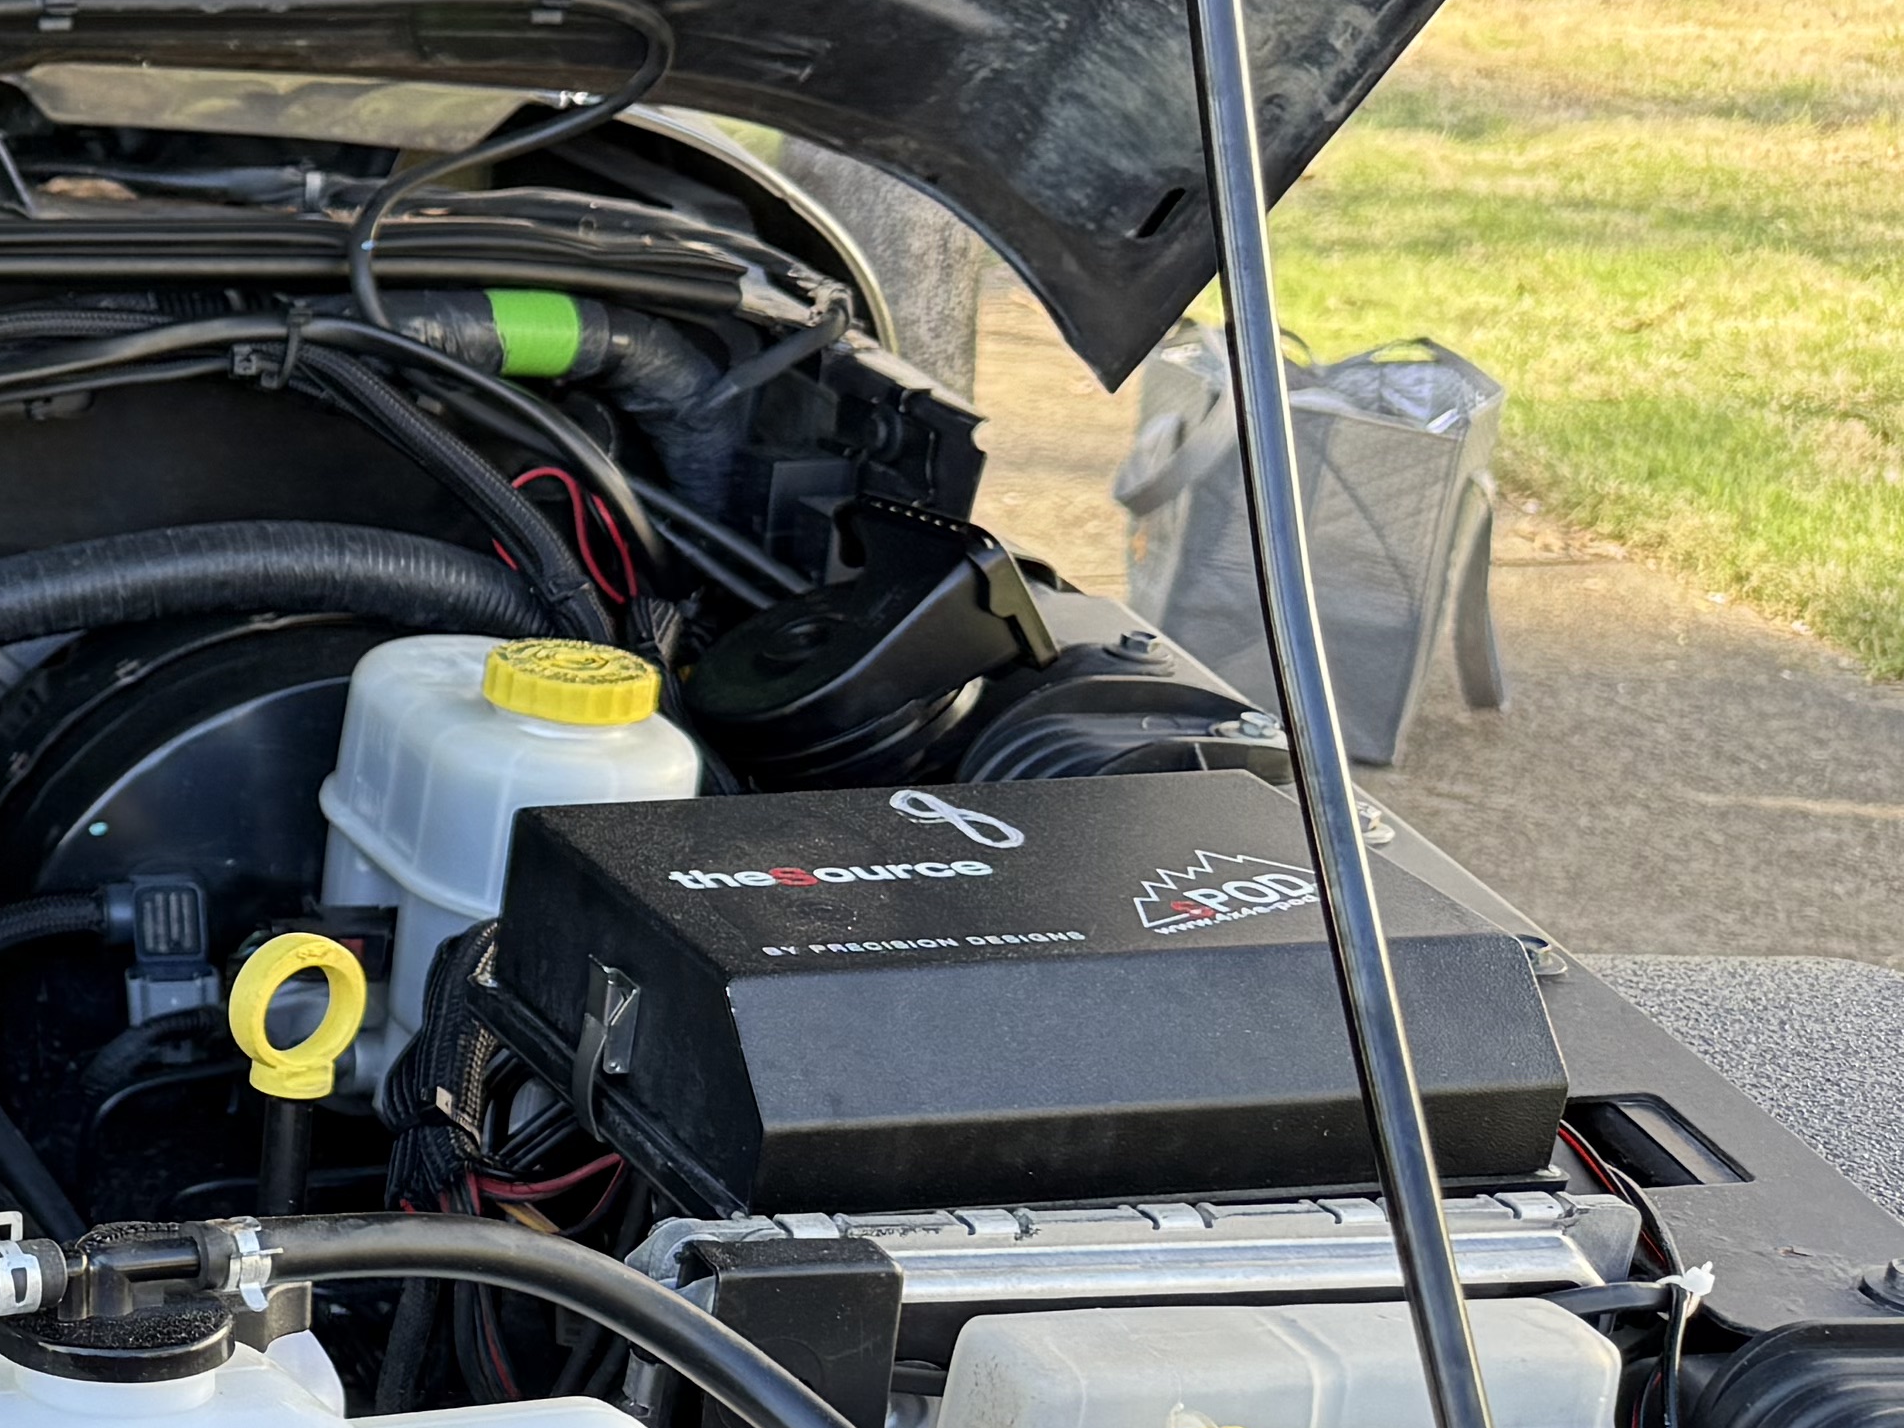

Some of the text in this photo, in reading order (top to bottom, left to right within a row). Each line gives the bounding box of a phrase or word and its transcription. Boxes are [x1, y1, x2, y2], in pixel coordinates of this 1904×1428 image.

[668, 859, 993, 890] theSource
[761, 930, 1087, 957] BY PRECISION DESIGNS
